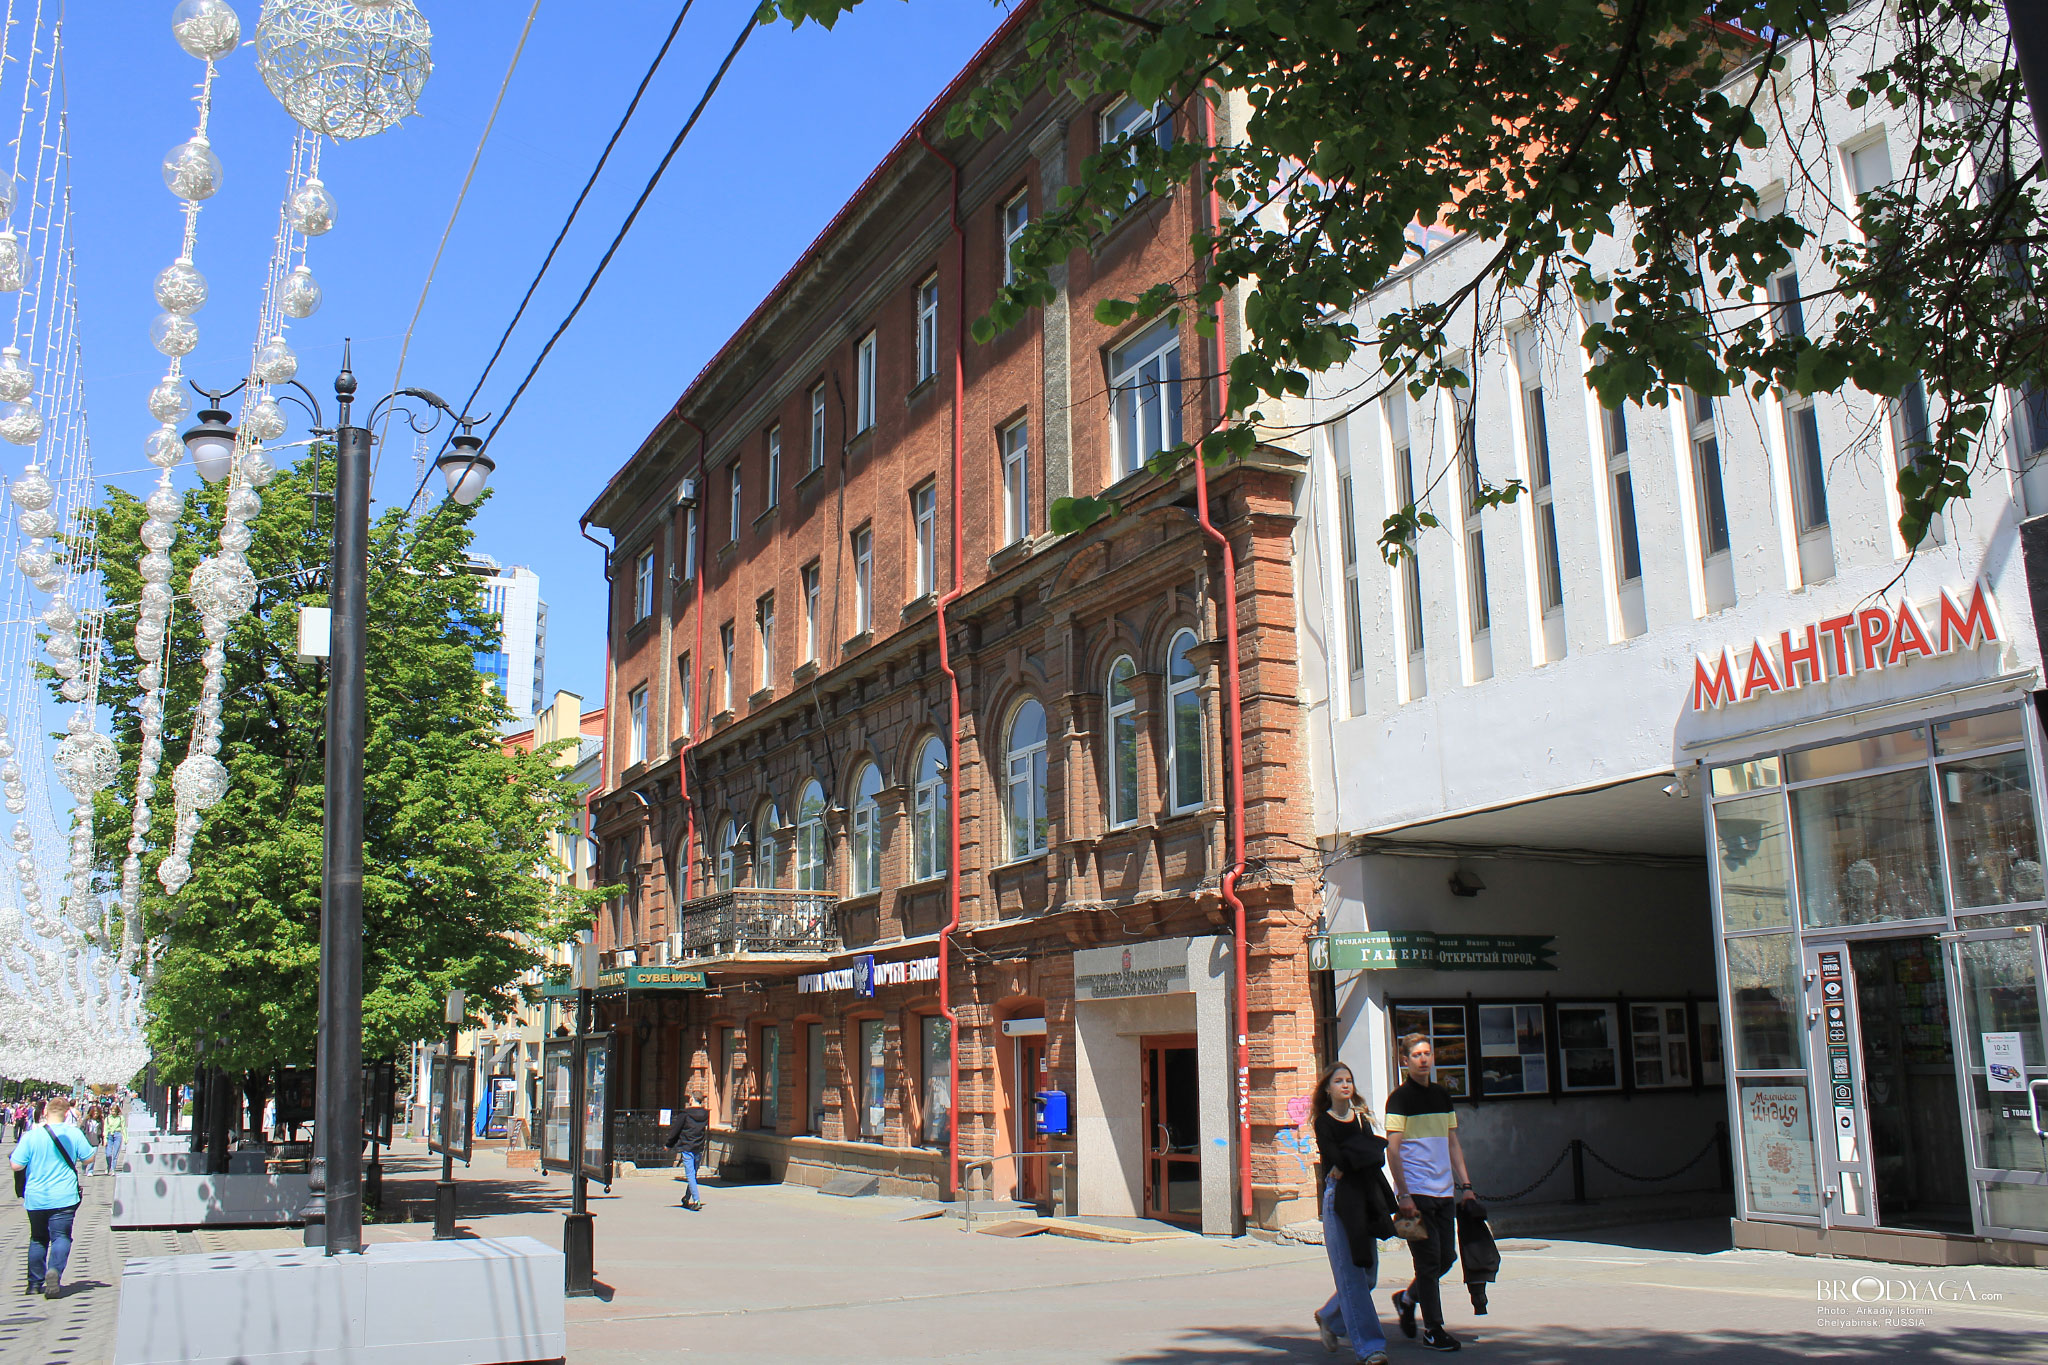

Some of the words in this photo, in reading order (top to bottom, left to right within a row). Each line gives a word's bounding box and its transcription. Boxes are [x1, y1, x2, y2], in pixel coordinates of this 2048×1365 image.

[1693, 576, 2006, 712] МАНТРАМ
[637, 972, 701, 983] СУВЕНИРЫ
[1829, 1020, 1844, 1028] VISA
[2011, 1109, 2031, 1117] ТОЛКА
